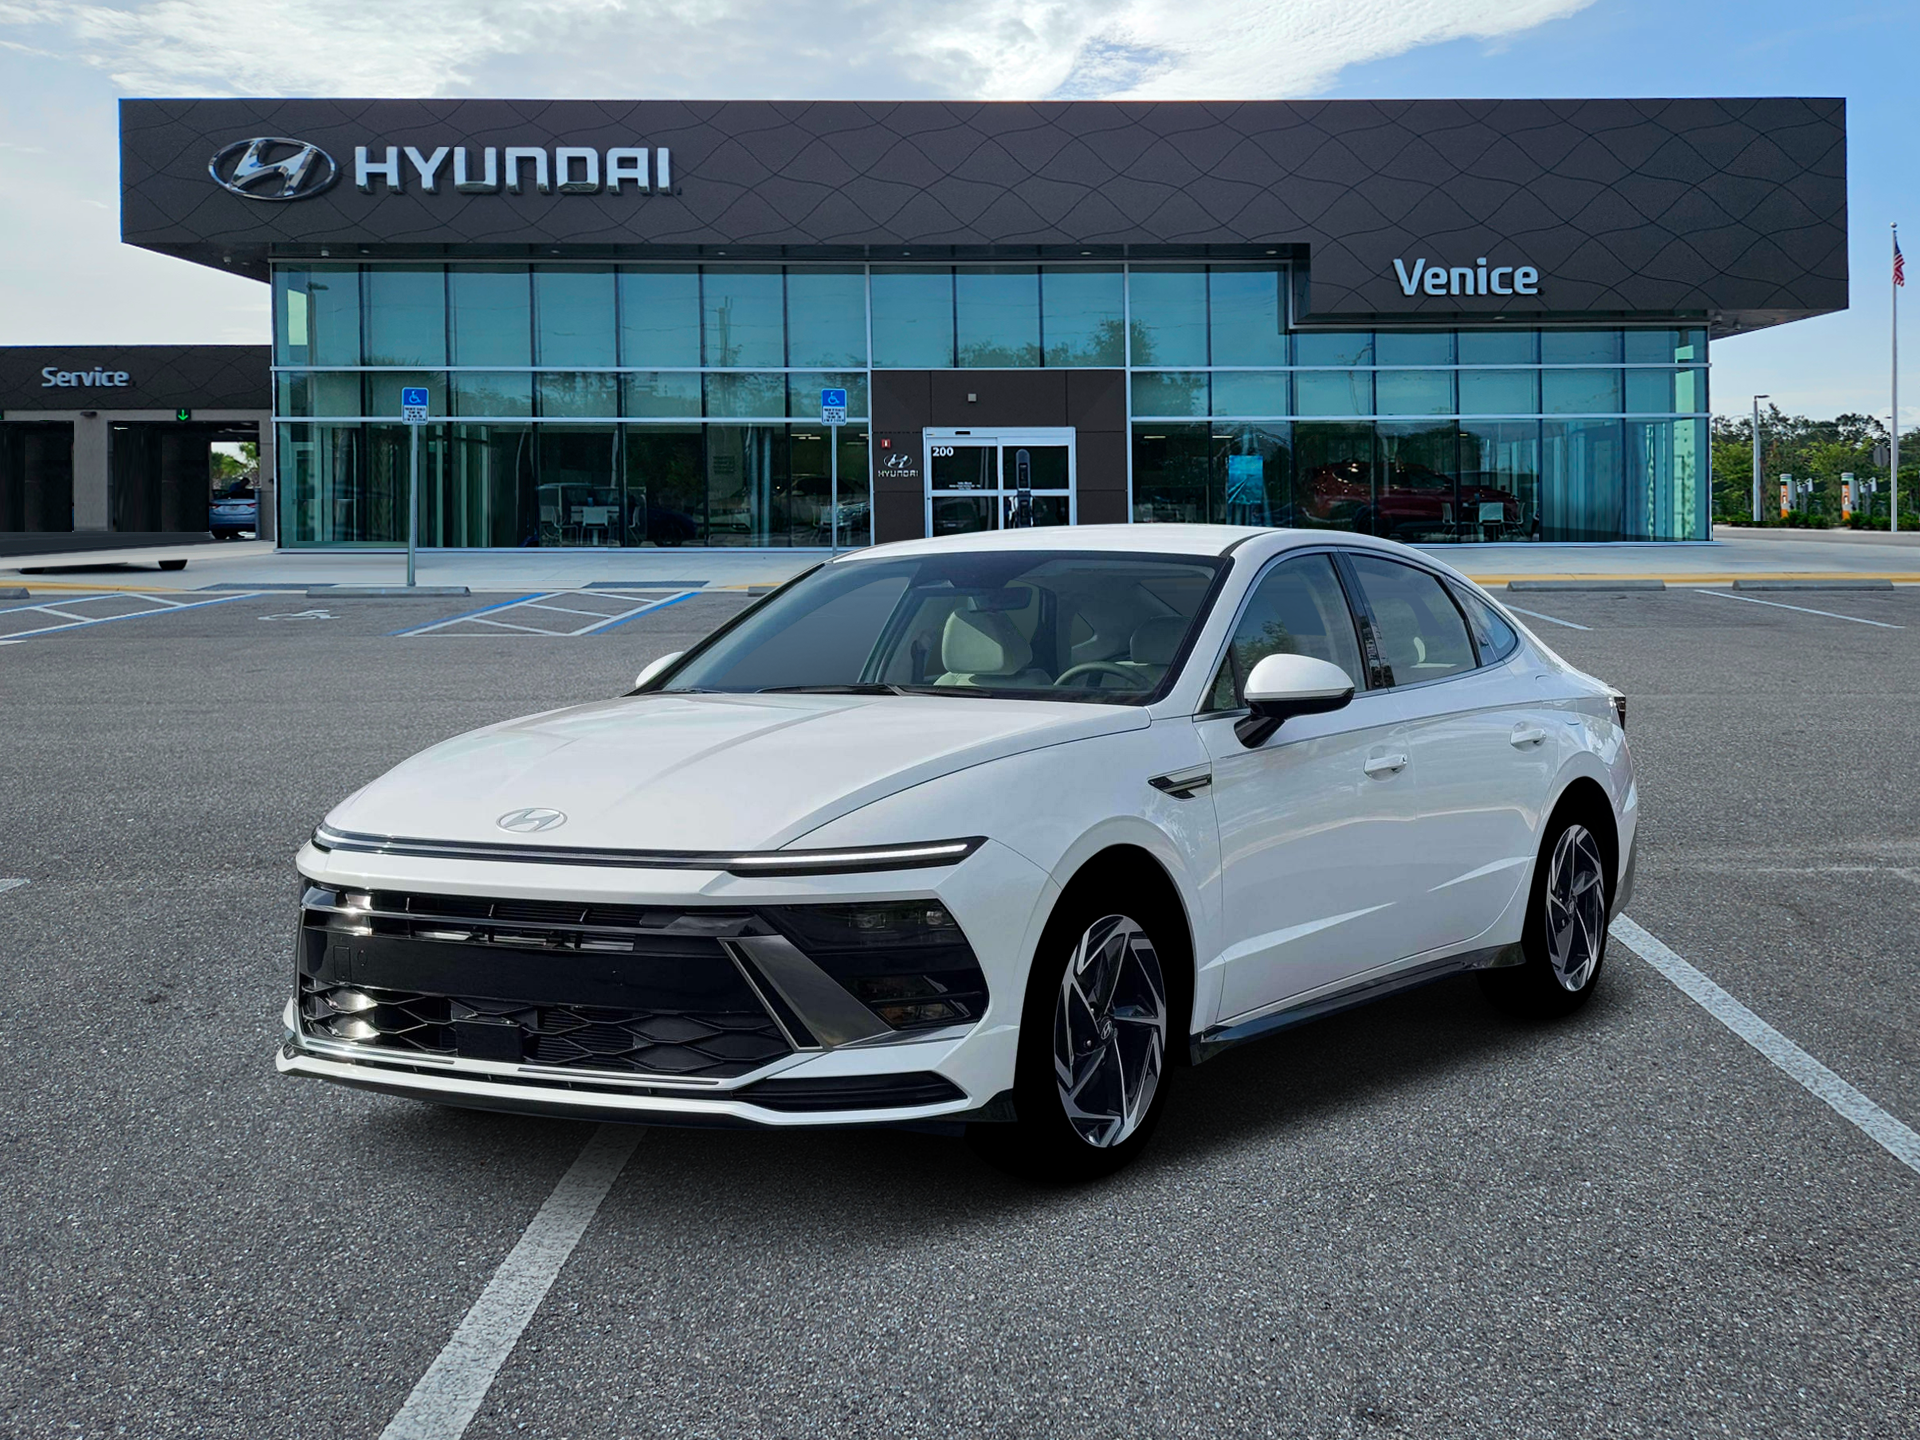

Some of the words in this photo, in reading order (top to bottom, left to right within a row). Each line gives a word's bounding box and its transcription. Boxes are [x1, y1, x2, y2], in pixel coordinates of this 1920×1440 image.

[354, 146, 671, 195] HYUNDAI
[1392, 256, 1539, 296] Venice
[41, 366, 130, 388] Service
[932, 446, 954, 457] 200
[877, 469, 919, 478] HYUNDAI
